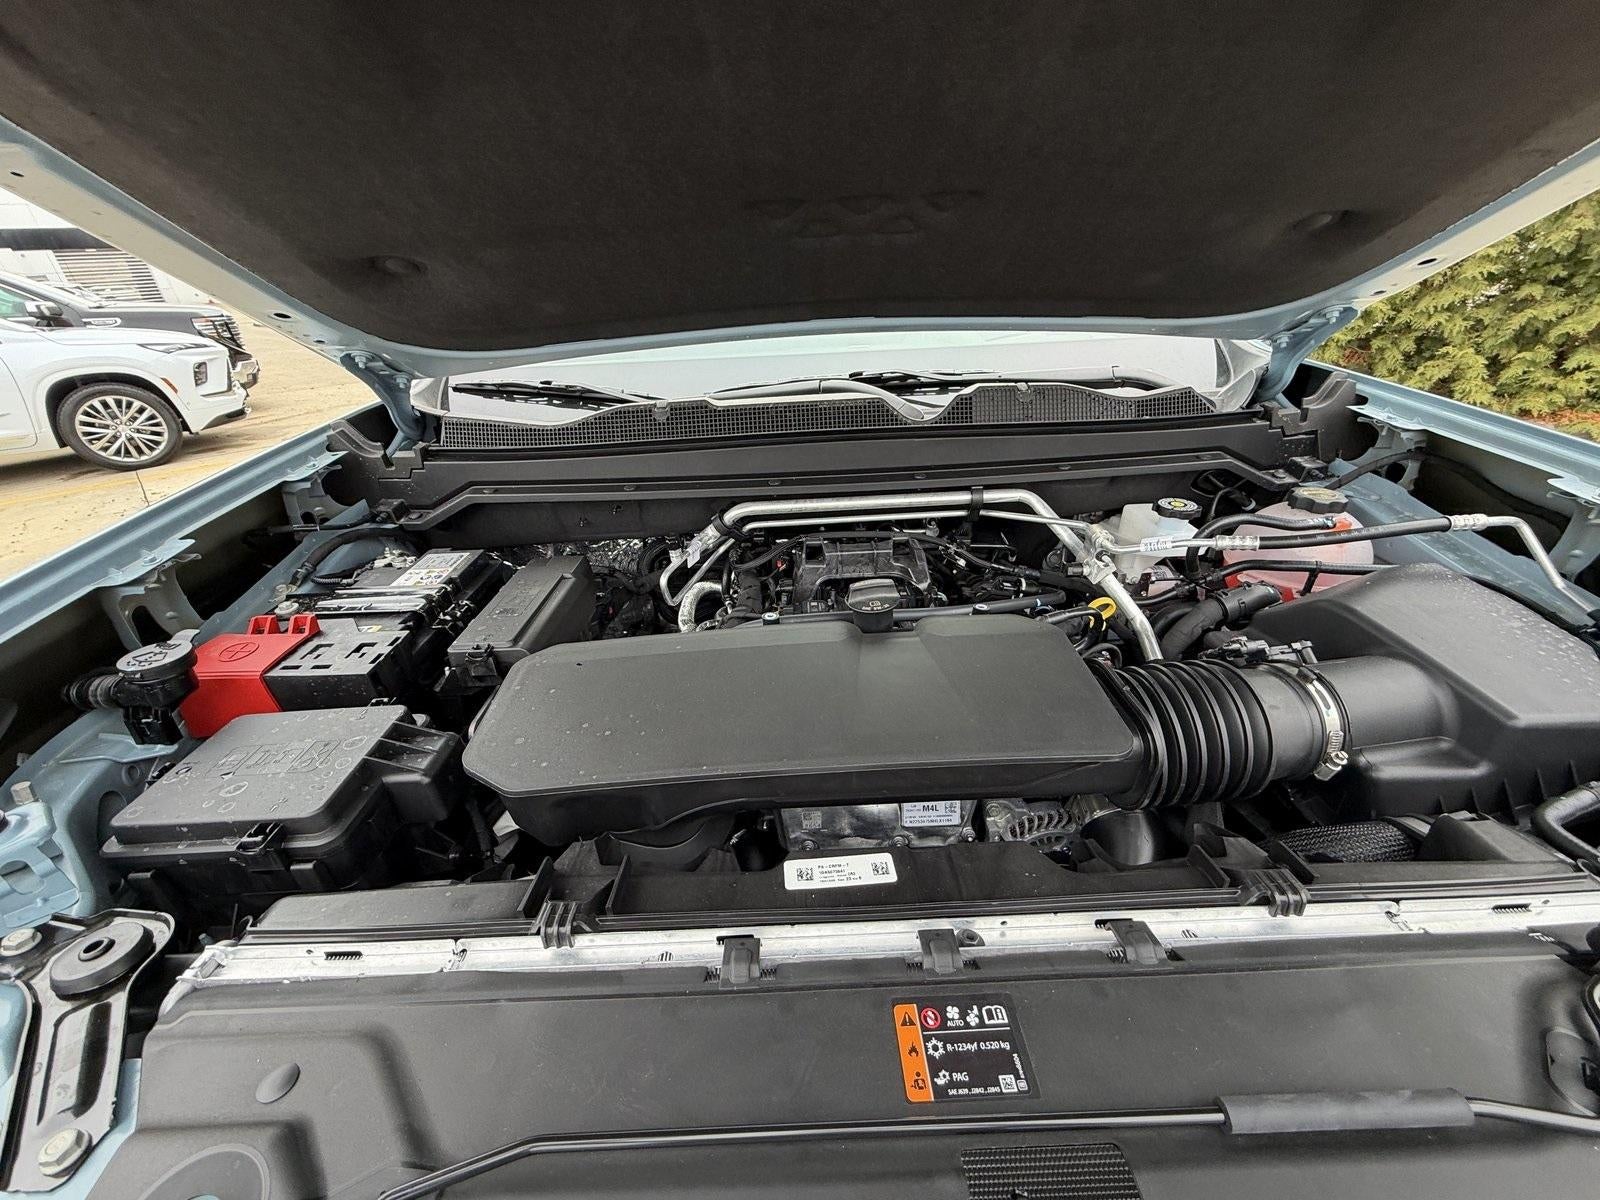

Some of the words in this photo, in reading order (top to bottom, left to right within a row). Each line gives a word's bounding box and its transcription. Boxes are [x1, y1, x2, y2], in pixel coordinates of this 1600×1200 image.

[922, 804, 939, 812] M4L
[946, 1042, 978, 1052] R-1234yf
[980, 1041, 999, 1050] 0.520
[1000, 1041, 1010, 1050] kg
[952, 1072, 969, 1081] PAG
